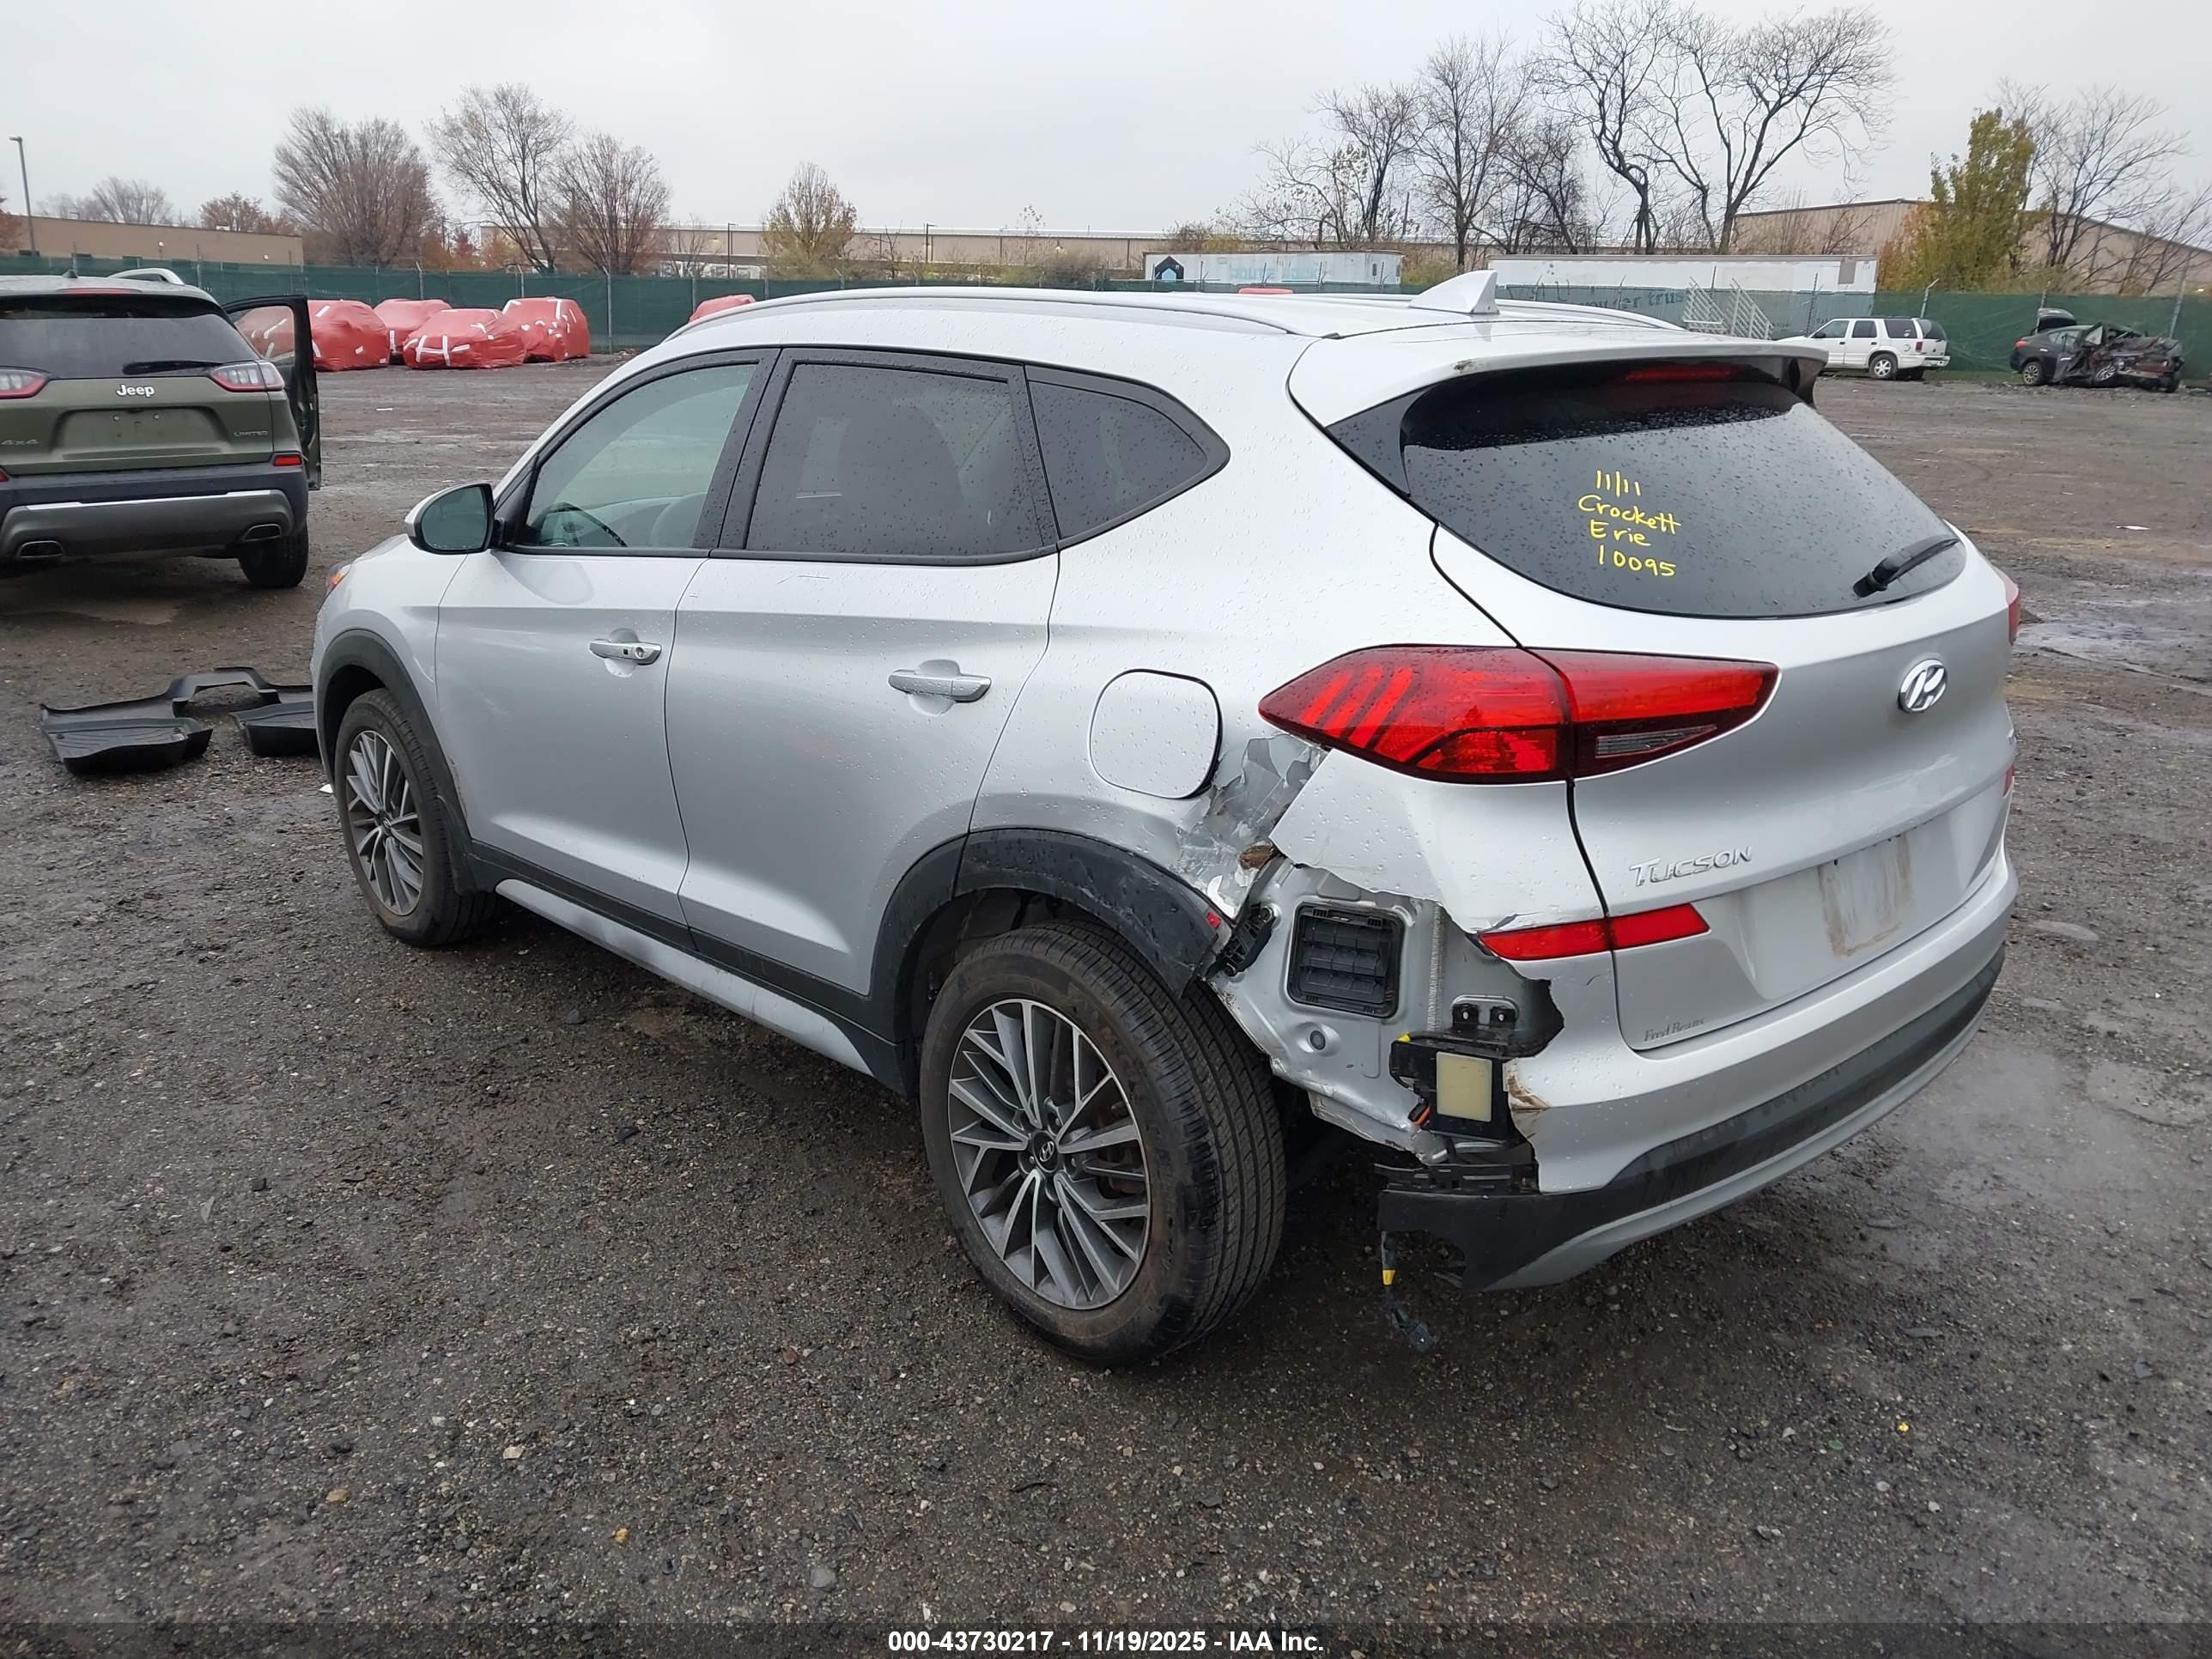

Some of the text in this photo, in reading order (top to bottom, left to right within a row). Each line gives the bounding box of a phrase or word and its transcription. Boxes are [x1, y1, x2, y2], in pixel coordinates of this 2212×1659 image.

[116, 384, 155, 398] Jeep
[1596, 470, 1641, 496] 11/11
[1578, 495, 1681, 534] Crockett
[1589, 520, 1651, 547] Erie
[1598, 544, 1677, 577] 10095
